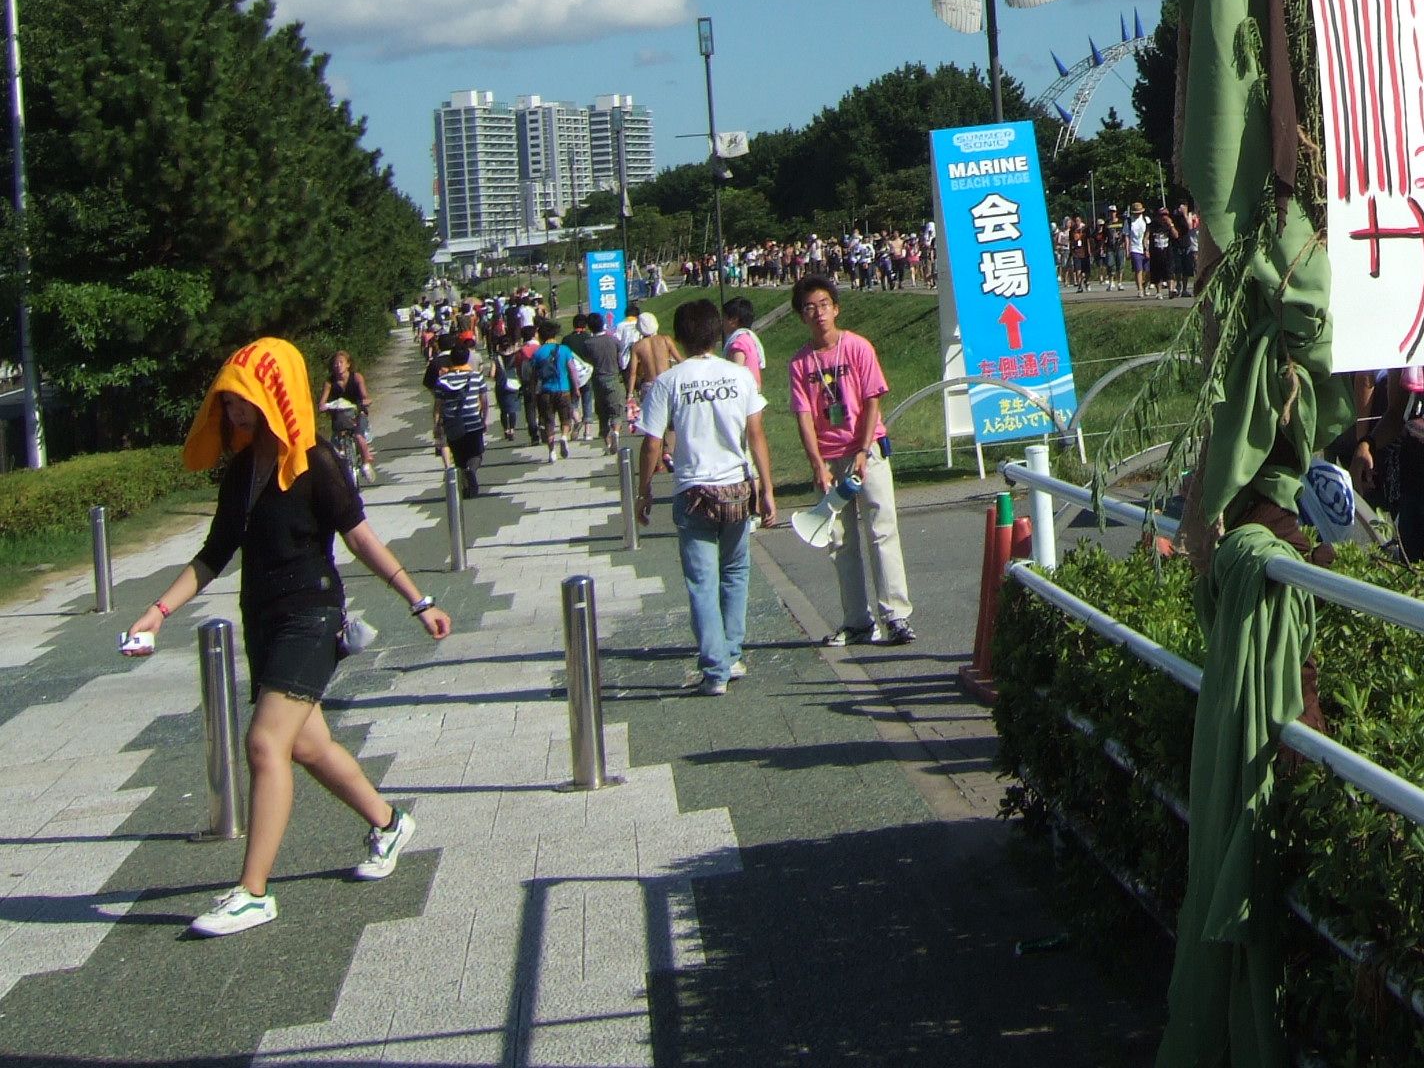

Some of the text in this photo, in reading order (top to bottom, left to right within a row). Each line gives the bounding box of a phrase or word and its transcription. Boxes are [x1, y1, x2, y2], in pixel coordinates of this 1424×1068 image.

[947, 156, 1029, 179] MARINE
[951, 171, 1031, 191] BEACH STAGE
[970, 193, 1030, 298] 会場
[681, 385, 739, 405] TACOS
